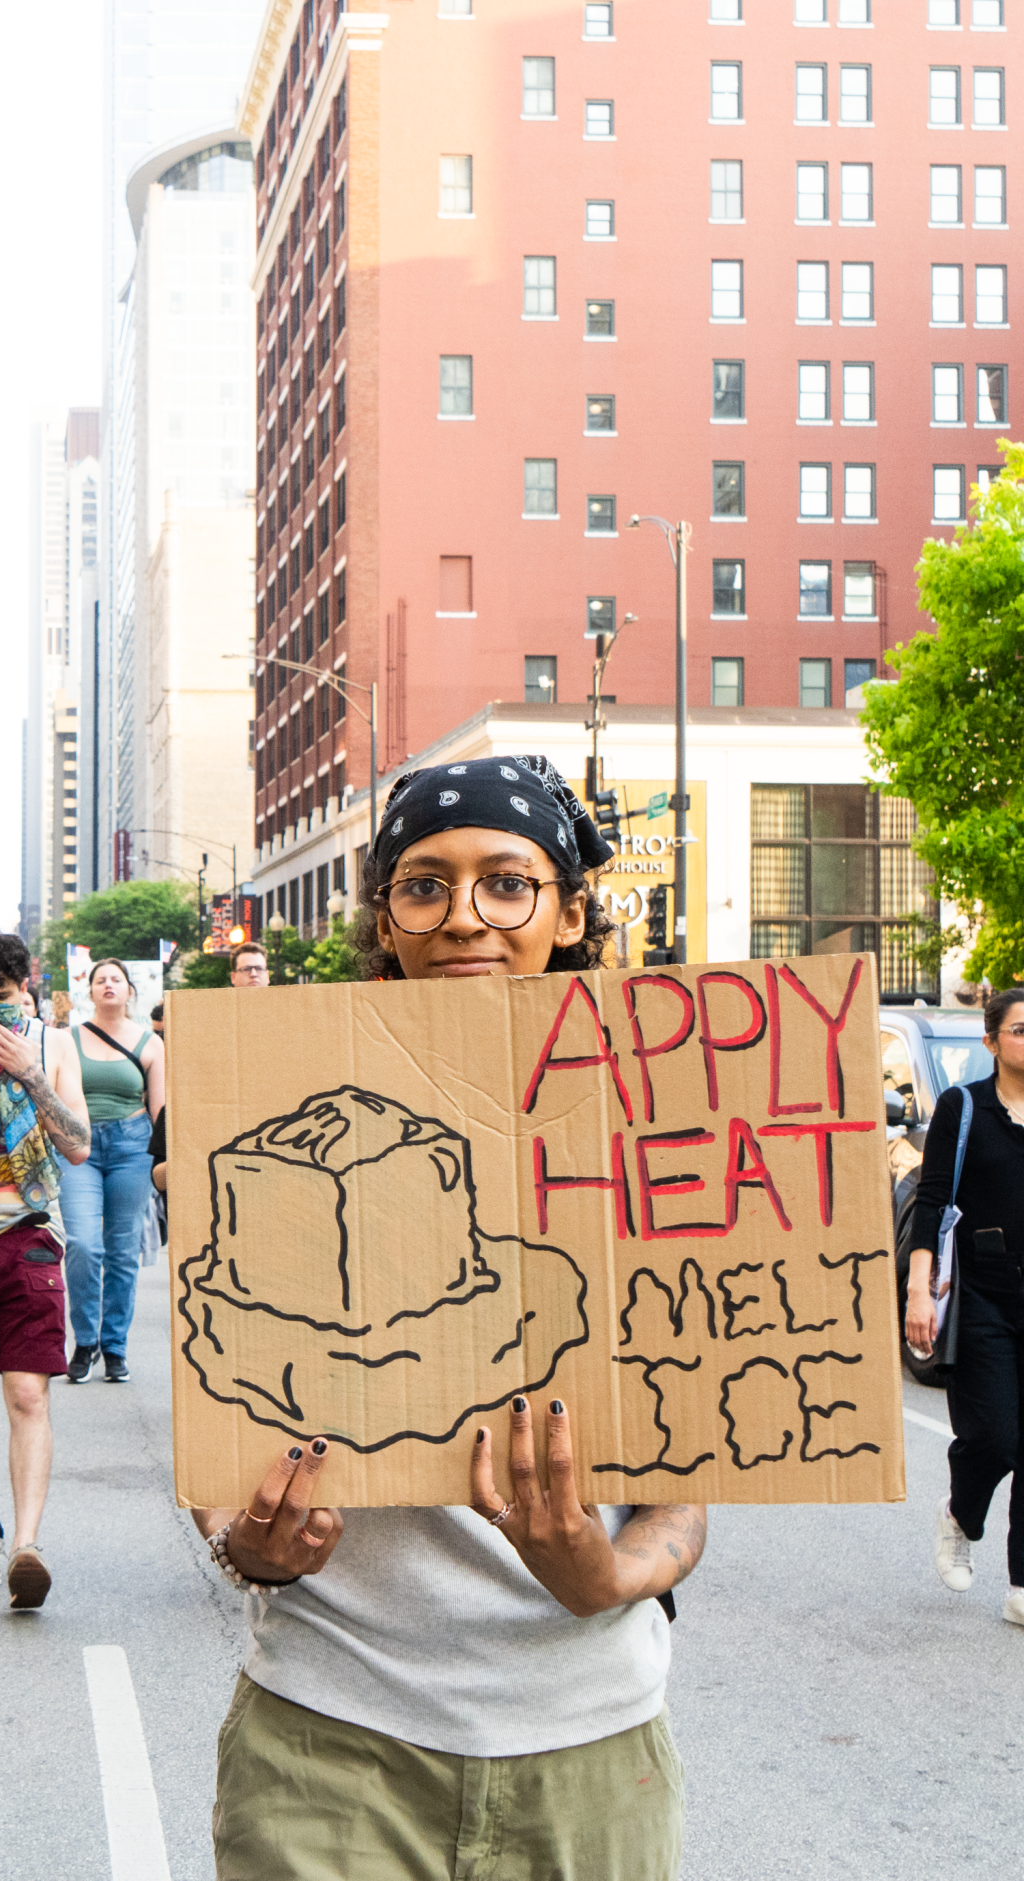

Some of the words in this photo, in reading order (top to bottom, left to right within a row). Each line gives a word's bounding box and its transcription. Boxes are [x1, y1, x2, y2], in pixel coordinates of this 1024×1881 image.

[613, 861, 667, 874] KHOUSE
[522, 959, 863, 1126] APPLY
[534, 1118, 876, 1240] HEAT
[619, 1250, 888, 1345] MELT
[592, 1351, 881, 1476] ICE
